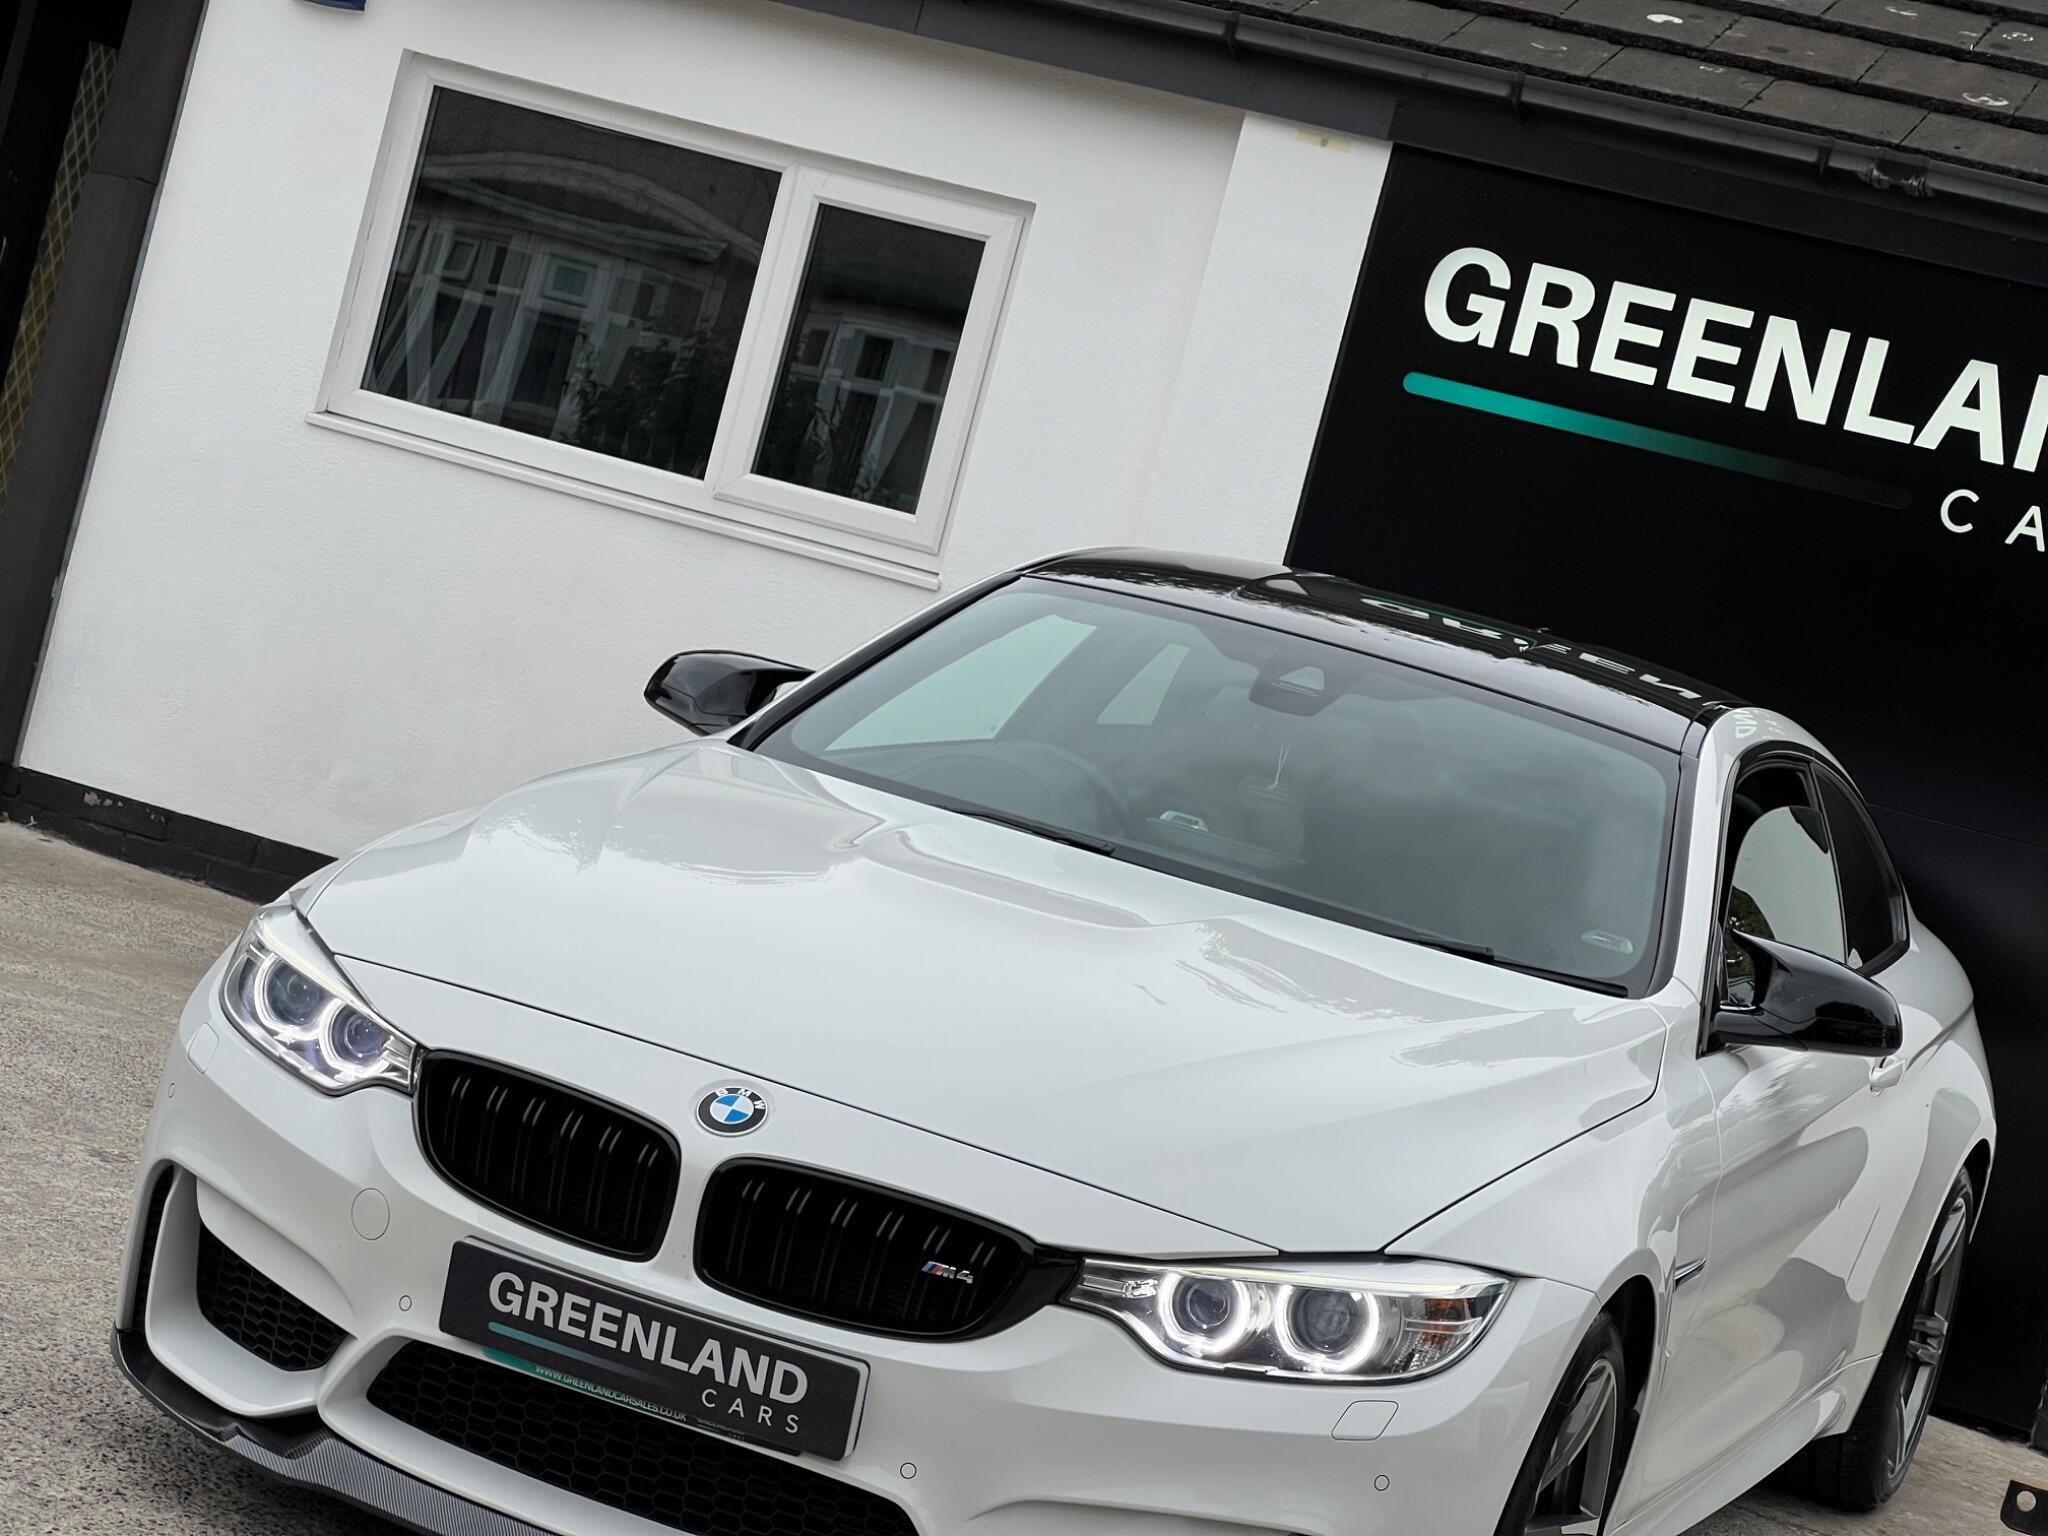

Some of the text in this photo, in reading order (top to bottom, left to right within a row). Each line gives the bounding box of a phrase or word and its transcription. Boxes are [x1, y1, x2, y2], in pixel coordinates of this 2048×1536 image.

[714, 1087, 767, 1111] BMW
[921, 1260, 974, 1284] M4
[489, 1271, 808, 1404] GREENLAND
[701, 1388, 800, 1435] CARS
